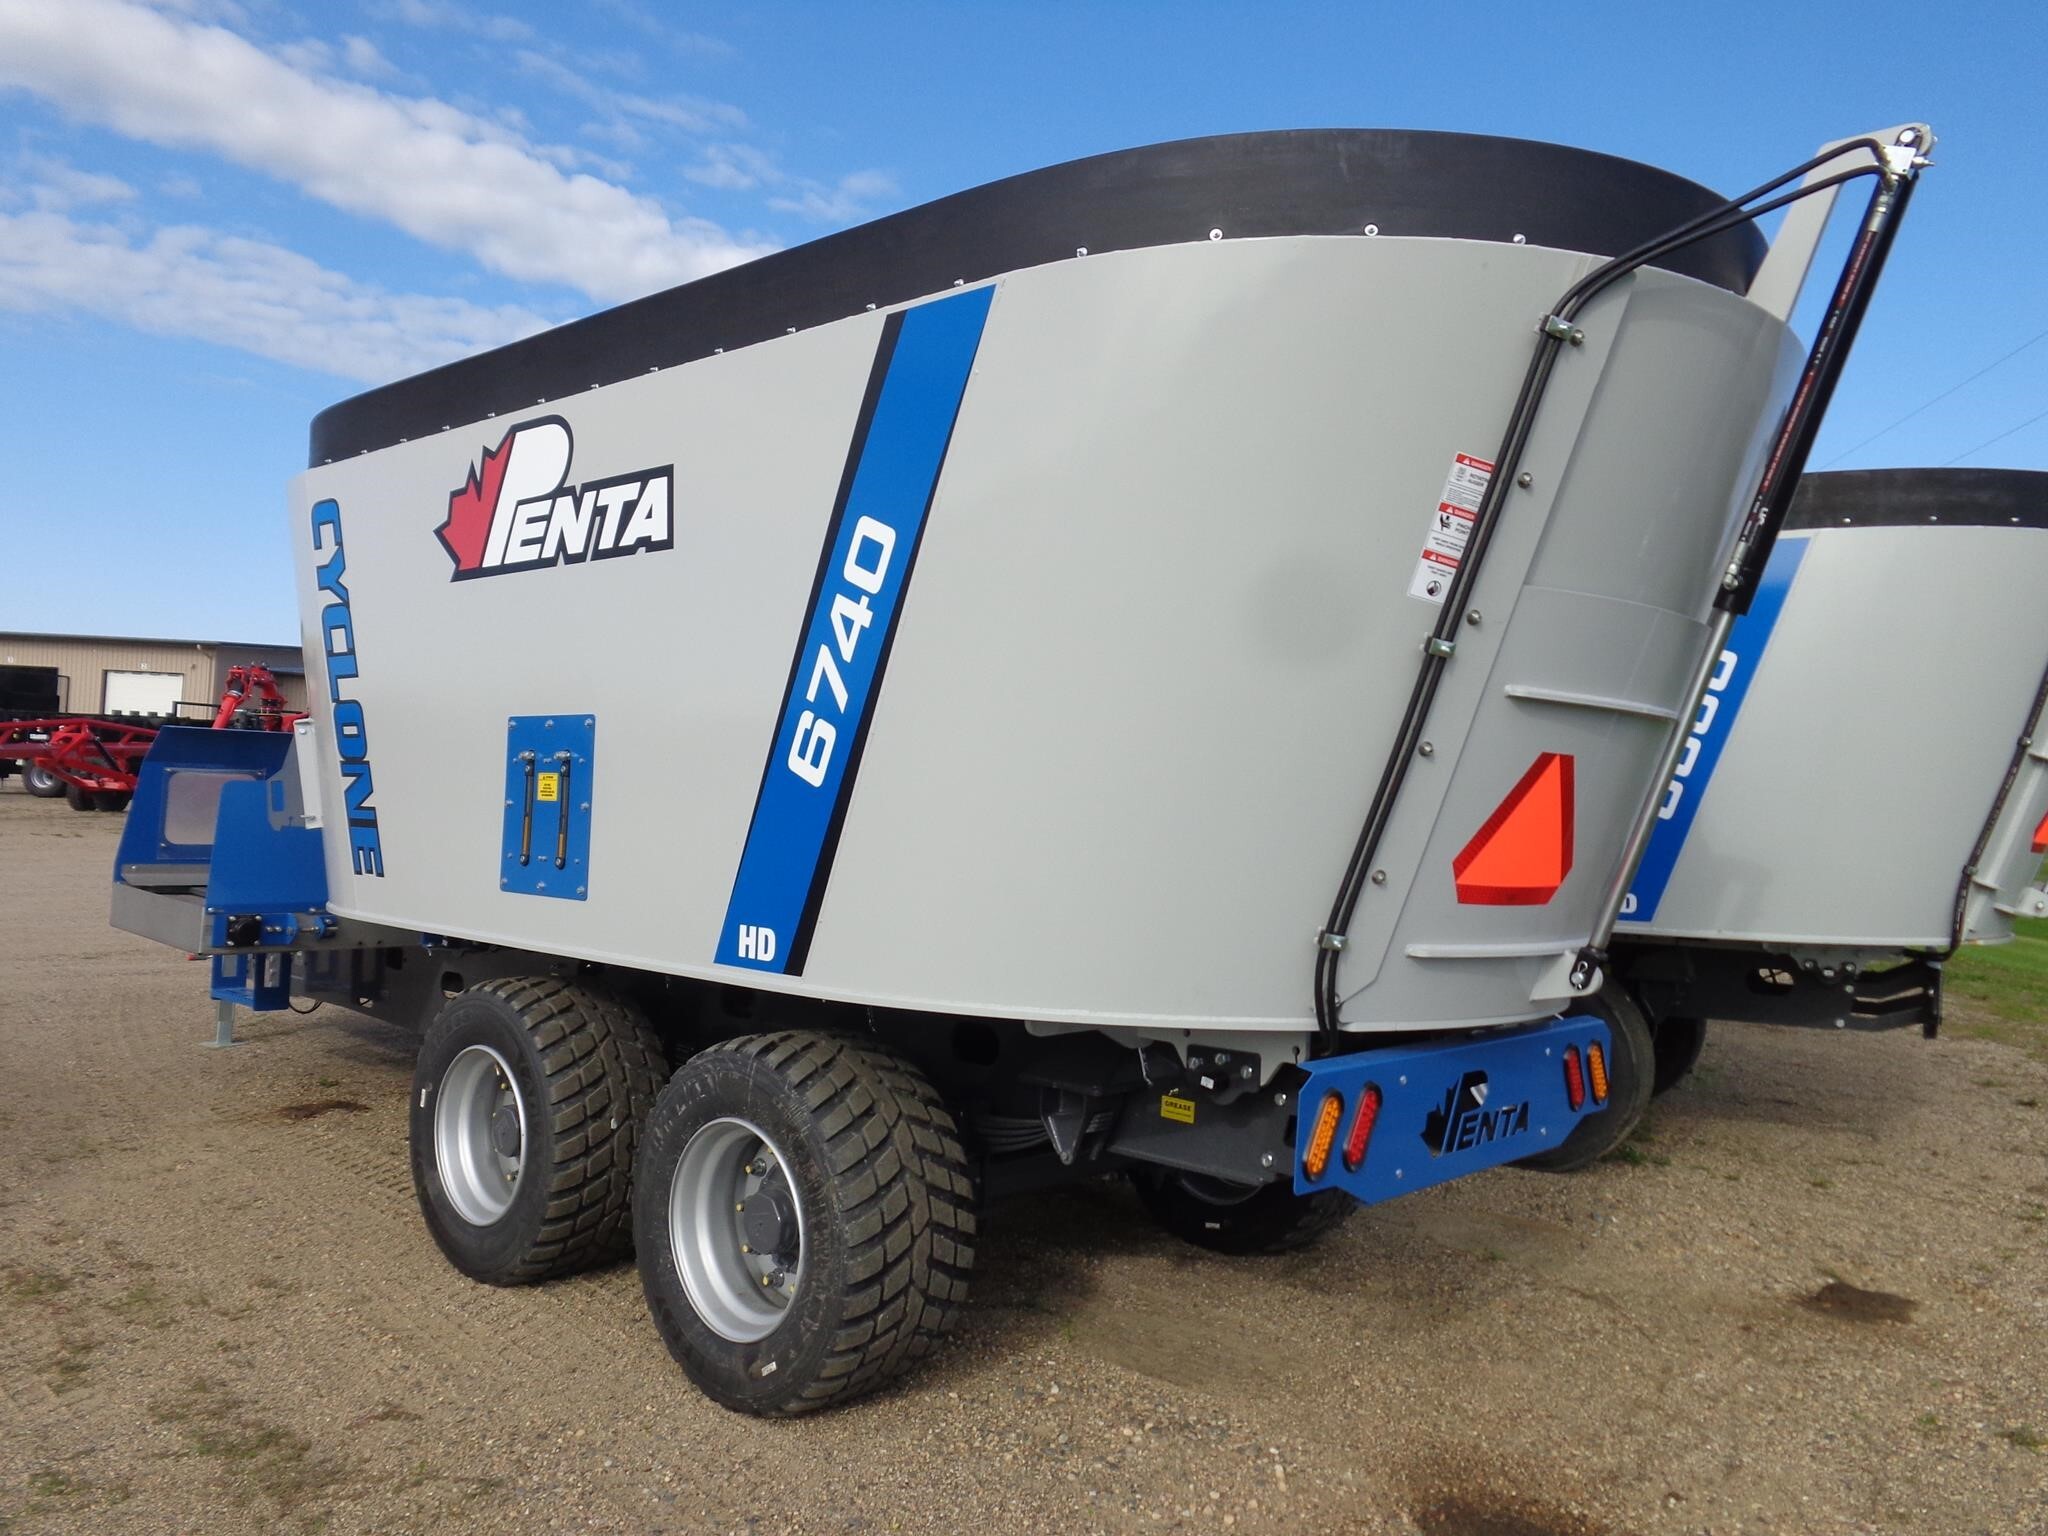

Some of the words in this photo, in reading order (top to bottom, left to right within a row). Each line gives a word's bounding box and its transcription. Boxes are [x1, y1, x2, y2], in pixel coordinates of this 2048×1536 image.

[480, 420, 670, 570] PENTA
[311, 498, 385, 878] CYCLONE
[787, 515, 897, 788] 6740
[737, 924, 776, 961] HD
[1619, 892, 1638, 914] D
[1164, 1099, 1192, 1112] GREASE
[1444, 1069, 1529, 1154] PENTA
